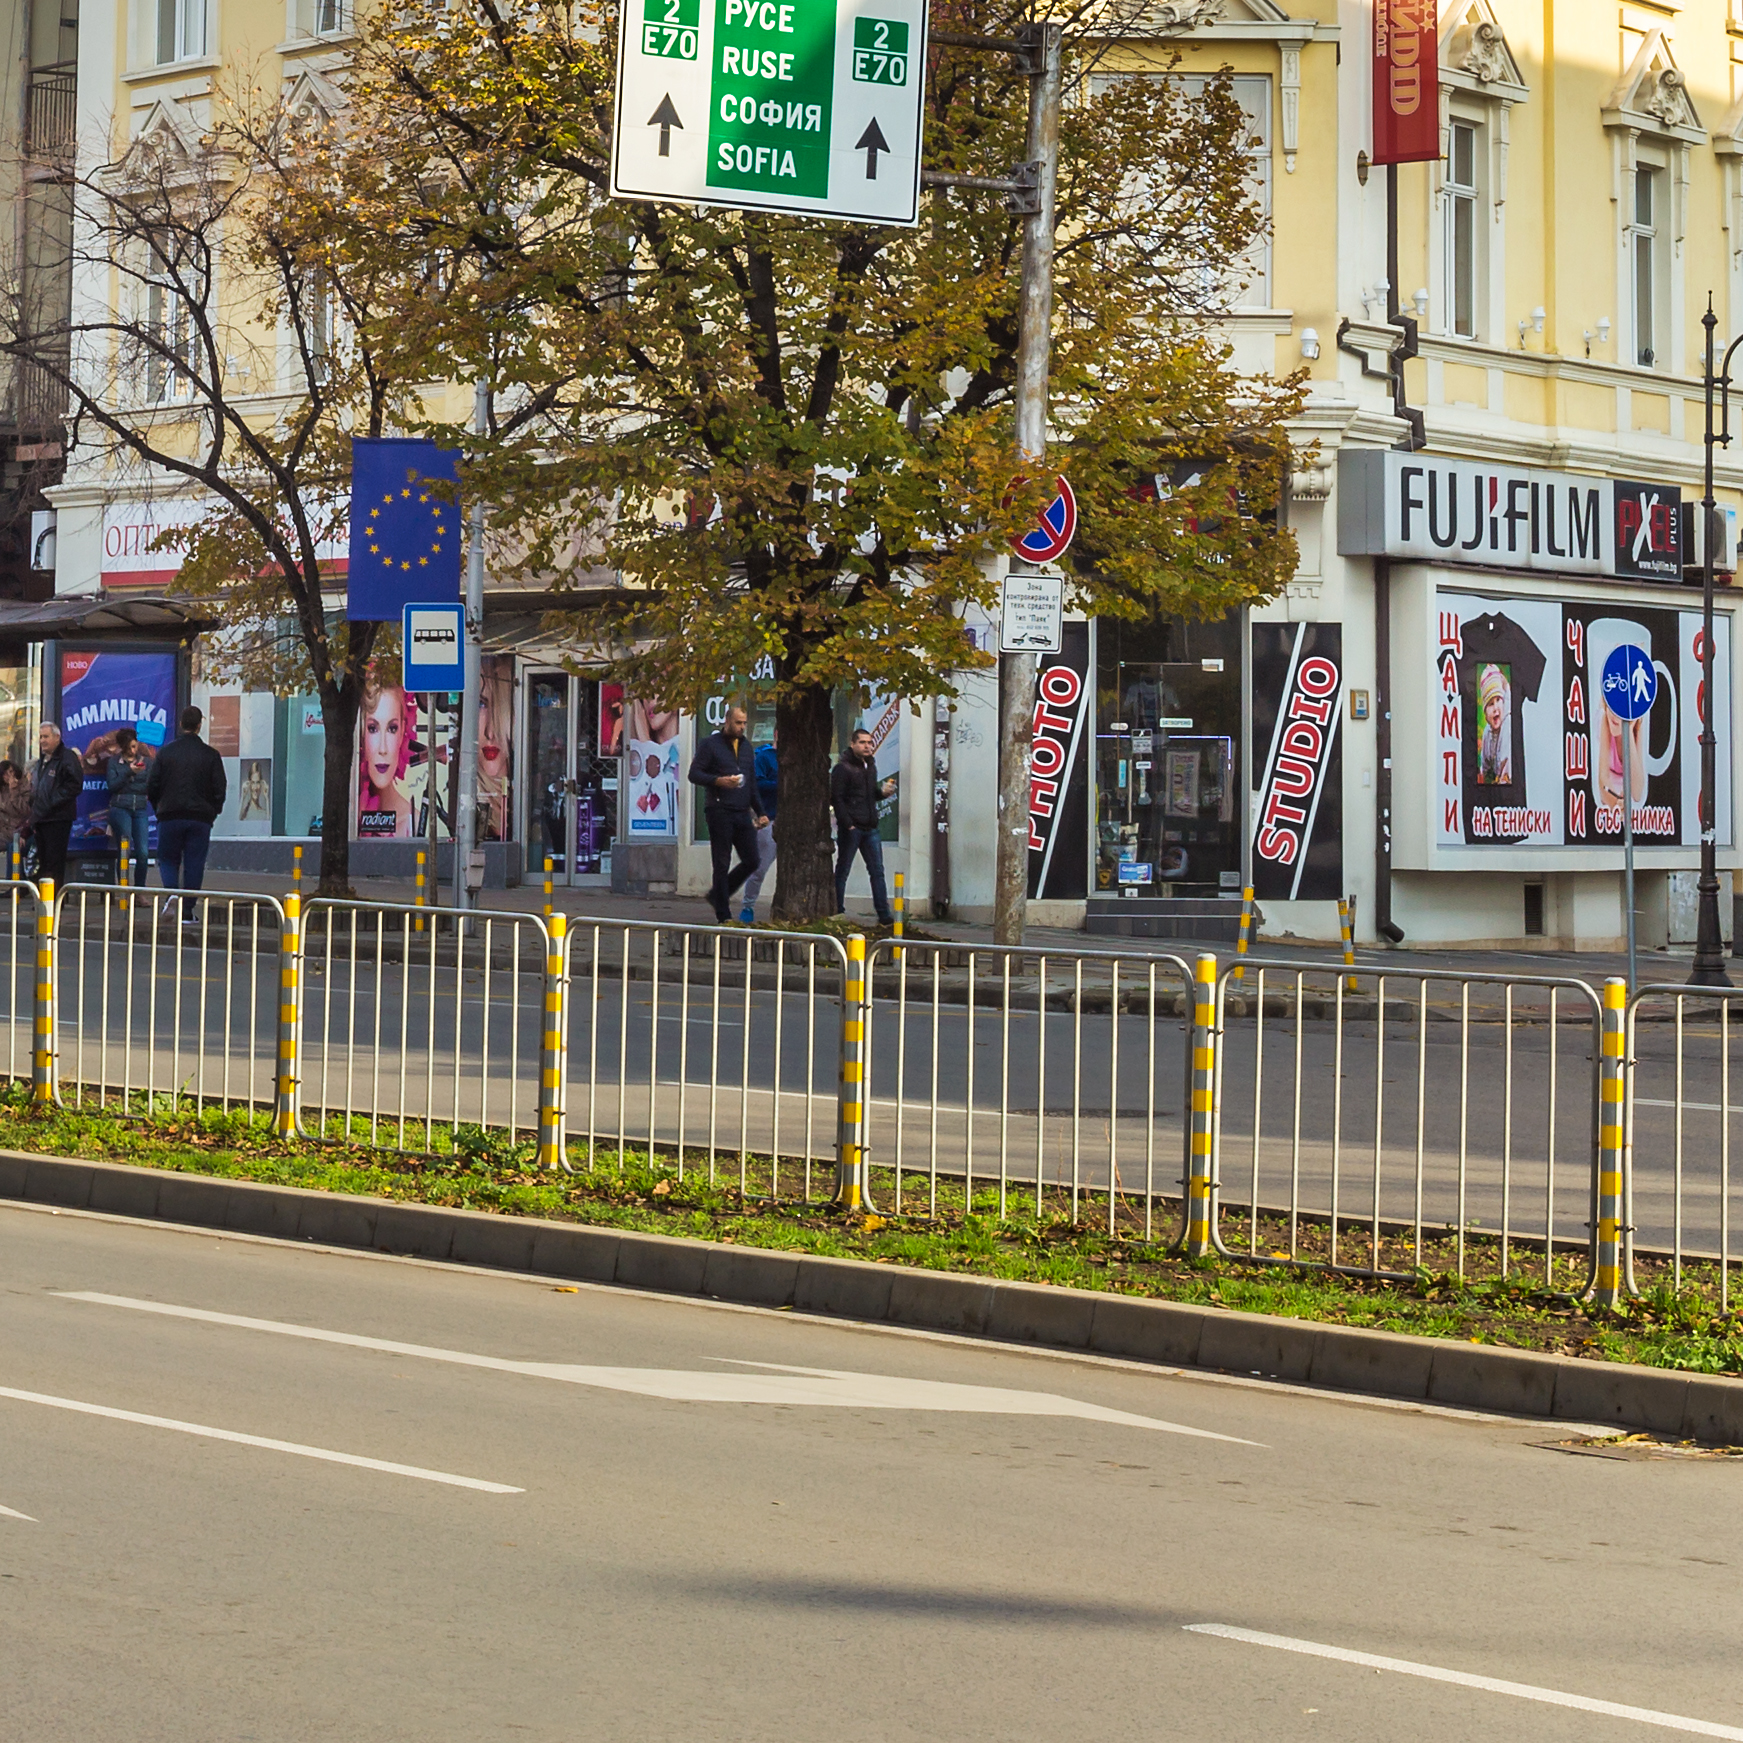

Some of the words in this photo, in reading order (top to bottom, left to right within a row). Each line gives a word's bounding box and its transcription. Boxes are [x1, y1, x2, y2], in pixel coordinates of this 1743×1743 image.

[643, 29, 697, 59] E70
[872, 21, 890, 50] 2
[721, 45, 794, 82] RUSE
[853, 53, 907, 85] E70
[719, 93, 822, 133] СОФИЯ
[716, 141, 798, 179] SOFIA
[1400, 465, 1601, 561] FUJIFILM
[1669, 507, 1678, 545] PLUS
[1027, 582, 1043, 591] Зона
[66, 660, 88, 671] НОВО
[66, 698, 168, 732] MMMILKA
[870, 703, 901, 753] ОДАРЪК
[1439, 610, 1463, 837] ЩАМПИ
[1566, 618, 1588, 838] ЧАШИ
[1257, 656, 1339, 866] STUDIO
[361, 812, 396, 827] radiant
[1472, 806, 1492, 837] НА
[1493, 806, 1553, 837] ТЕНИСКИ
[1594, 805, 1622, 832] СЪС
[1623, 806, 1676, 837] НИМКА
